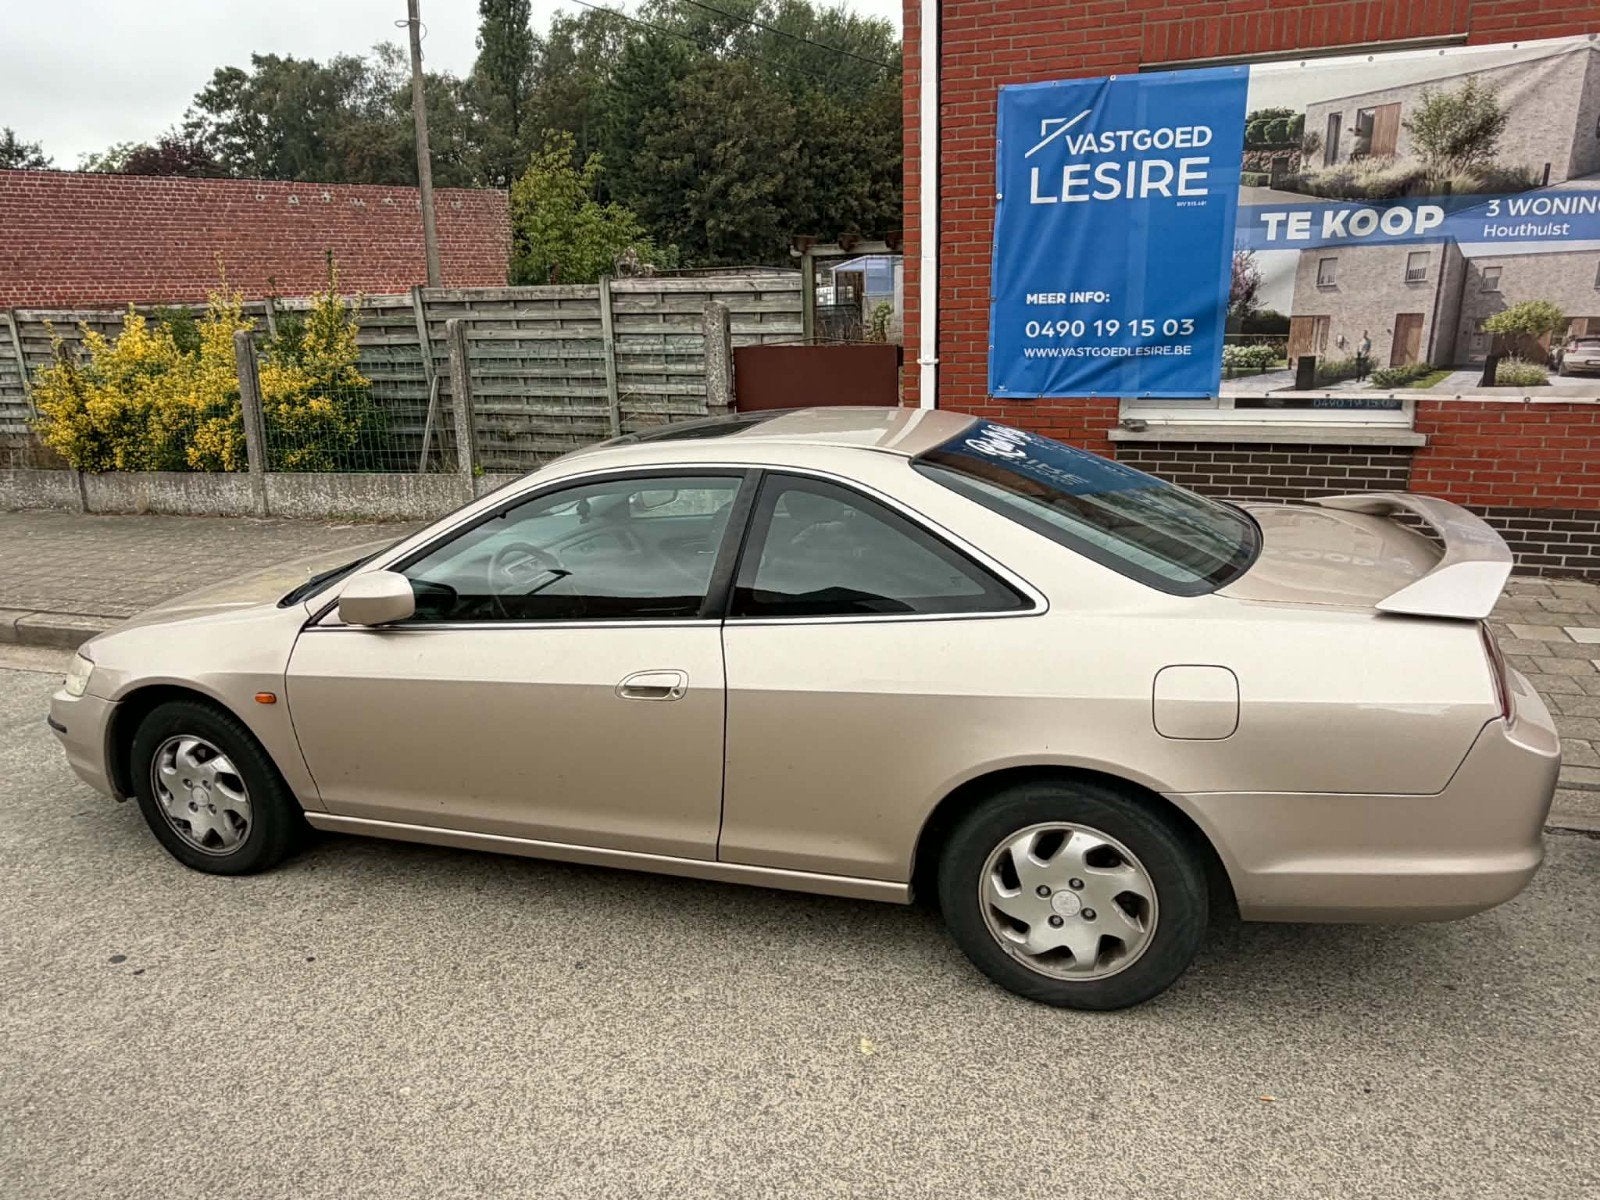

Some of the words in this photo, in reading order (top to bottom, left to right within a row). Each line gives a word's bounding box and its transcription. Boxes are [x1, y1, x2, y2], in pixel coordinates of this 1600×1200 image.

[1065, 125, 1213, 156] VASTGOED
[1029, 156, 1211, 205] LESIRE
[1485, 199, 1501, 217] 3
[1508, 196, 1600, 216] WONIN
[1260, 211, 1313, 241] TE
[1321, 205, 1445, 239] KOOP
[1483, 222, 1571, 238] Houthulst
[1026, 292, 1066, 305] MEER
[1070, 291, 1110, 304] INFO:
[1025, 319, 1086, 338] 0490
[1093, 319, 1121, 337] 19
[1128, 319, 1156, 337] 15
[1162, 318, 1195, 336] 03
[1024, 345, 1192, 358] WWW.VASTGOEDLESIRE.BE
